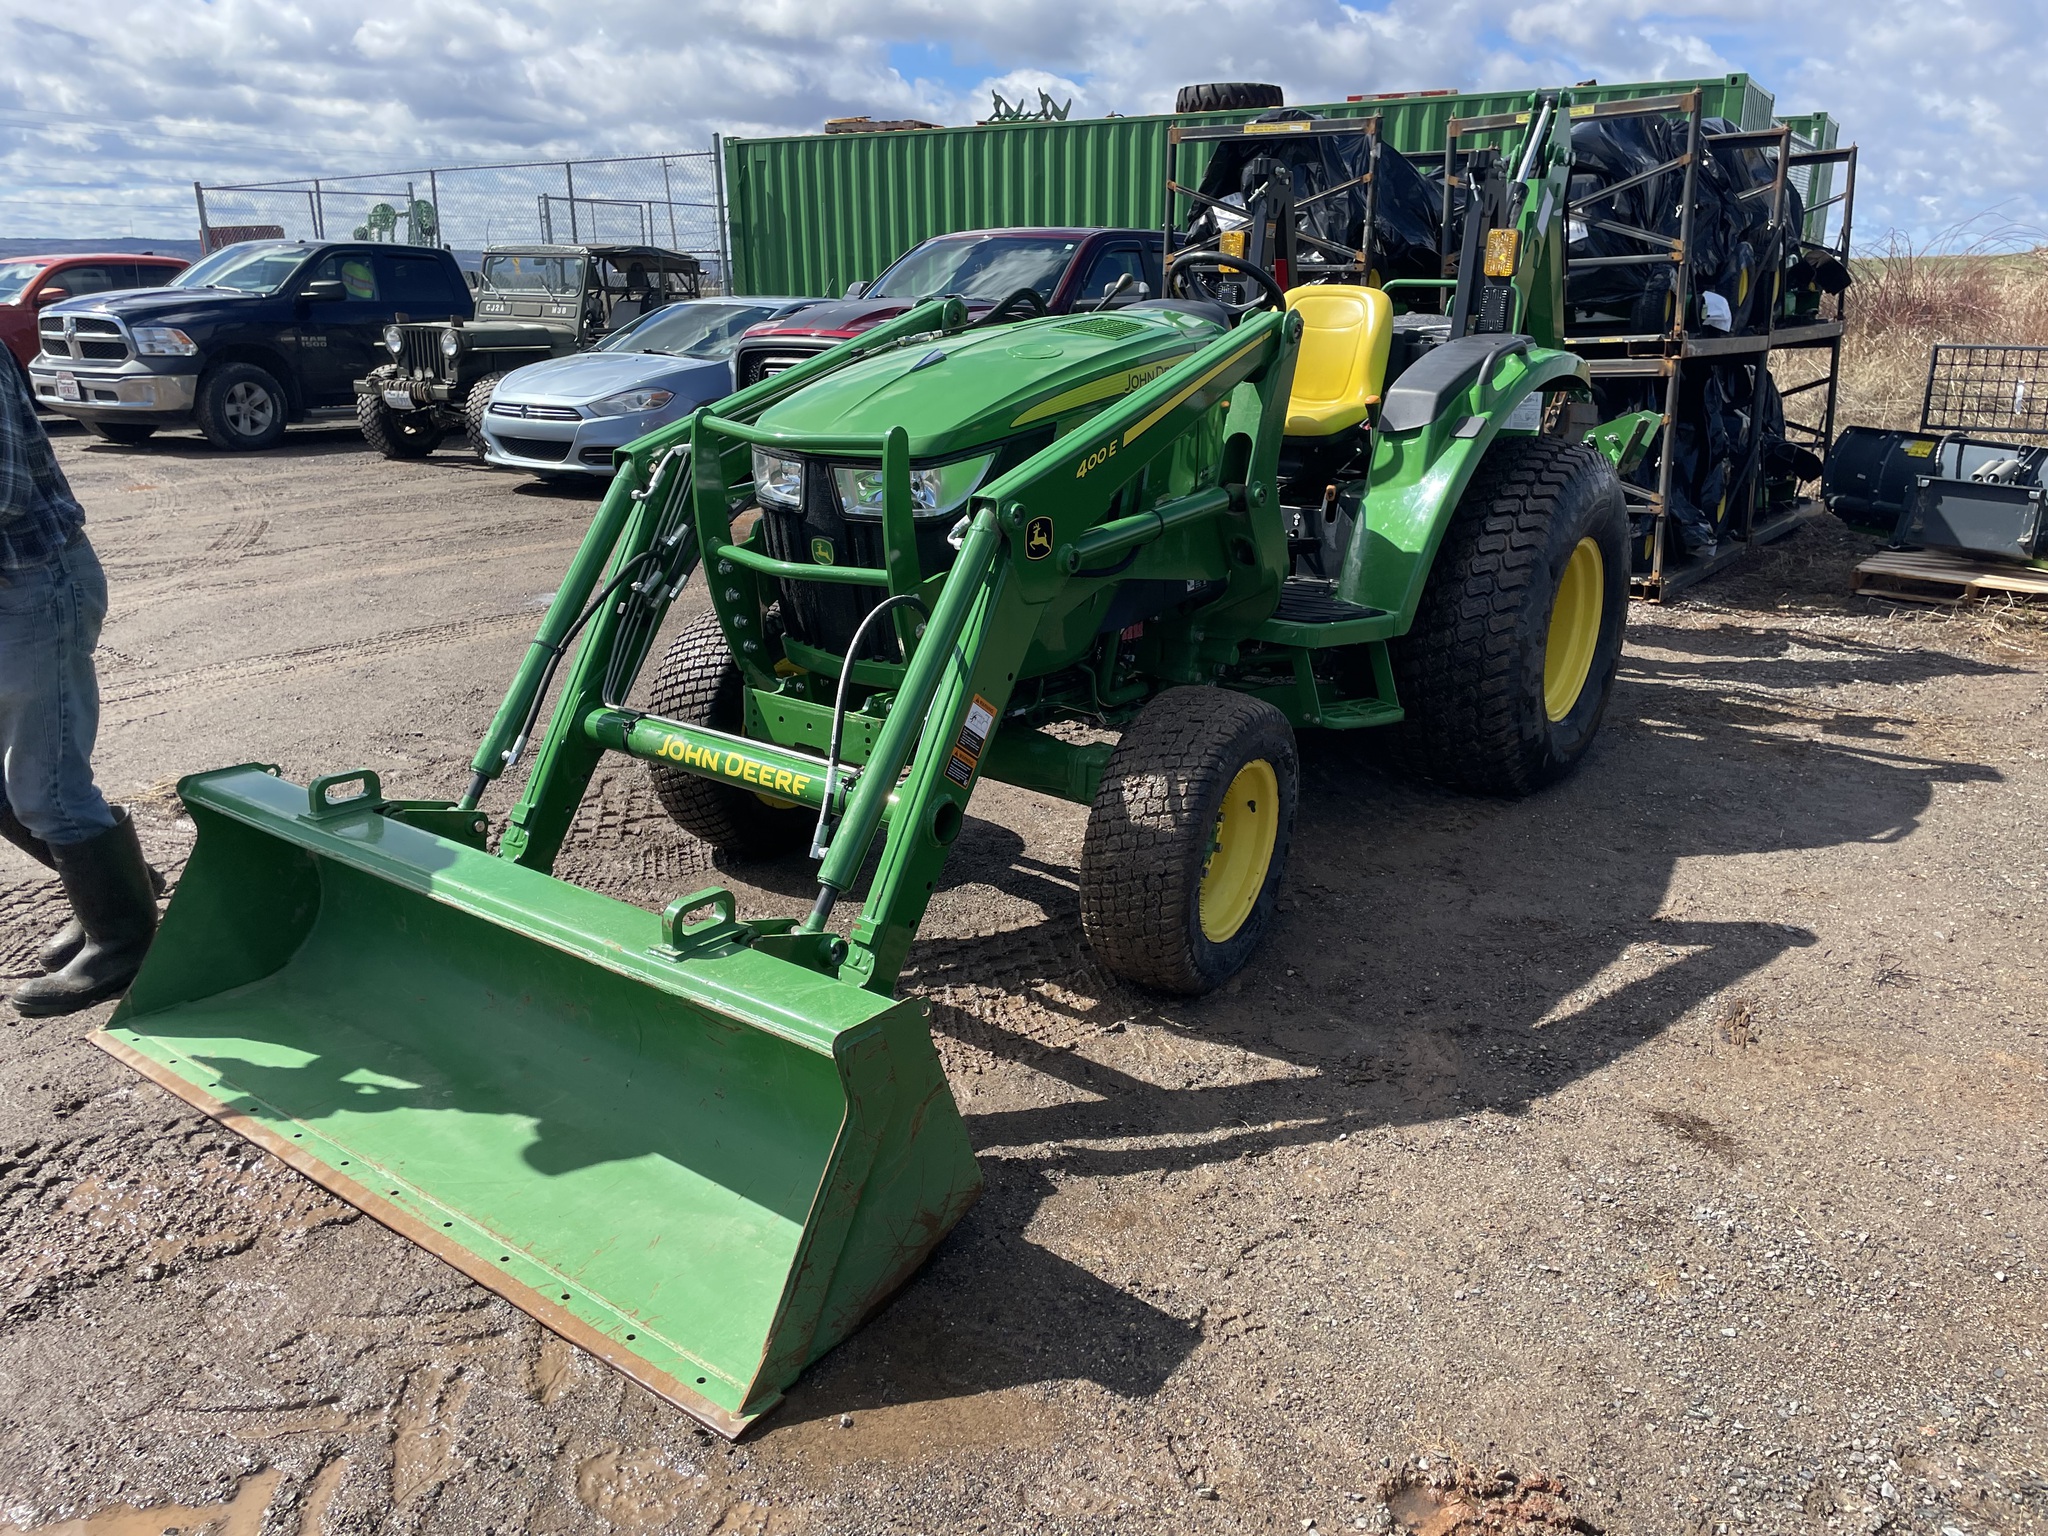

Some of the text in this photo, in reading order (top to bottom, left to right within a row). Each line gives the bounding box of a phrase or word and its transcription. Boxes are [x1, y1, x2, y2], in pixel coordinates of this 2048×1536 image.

[485, 303, 505, 312] CJ2A
[1124, 370, 1154, 392] JOHN
[655, 734, 721, 772] JOHN
